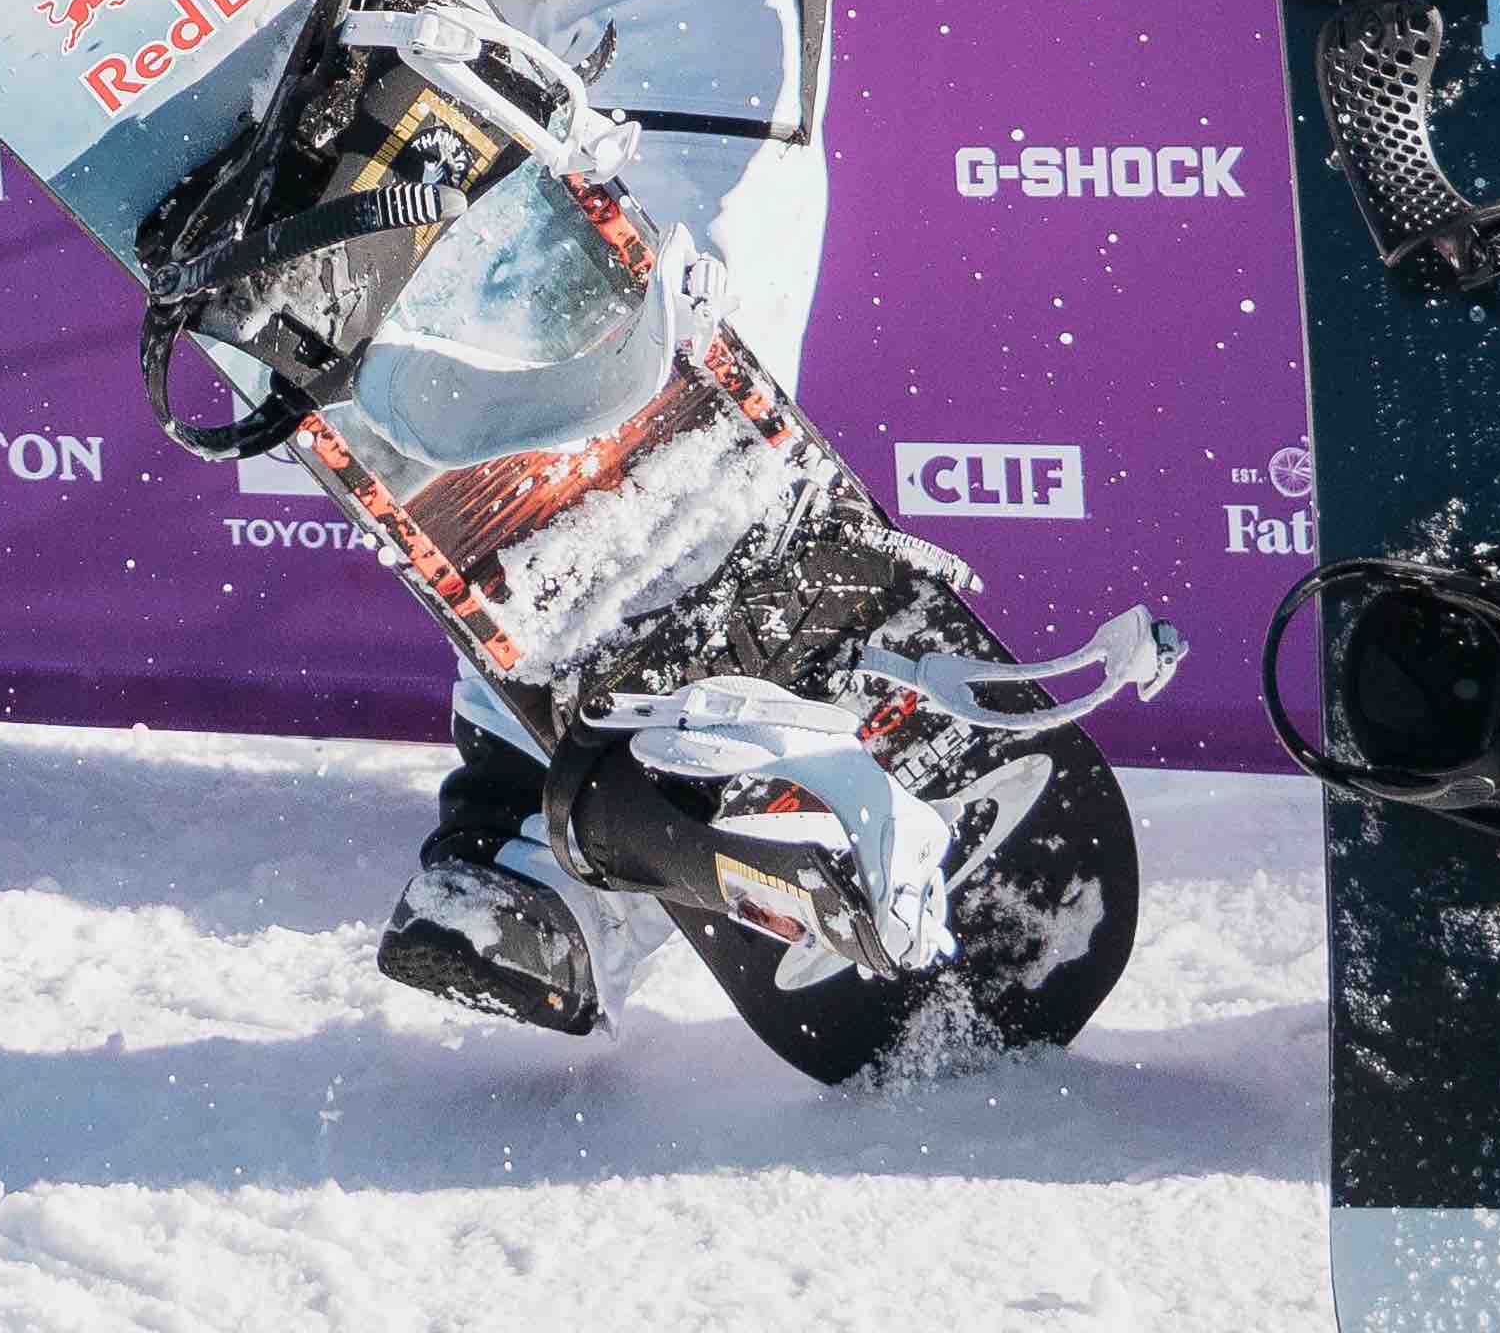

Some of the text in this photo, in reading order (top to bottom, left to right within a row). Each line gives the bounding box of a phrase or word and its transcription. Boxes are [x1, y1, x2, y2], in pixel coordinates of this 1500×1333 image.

[81, 0, 216, 117] Red
[954, 146, 1245, 200] G-SHOCK
[920, 455, 1064, 506] CLIF
[1230, 466, 1265, 486] EST.
[1222, 503, 1314, 556] Fat
